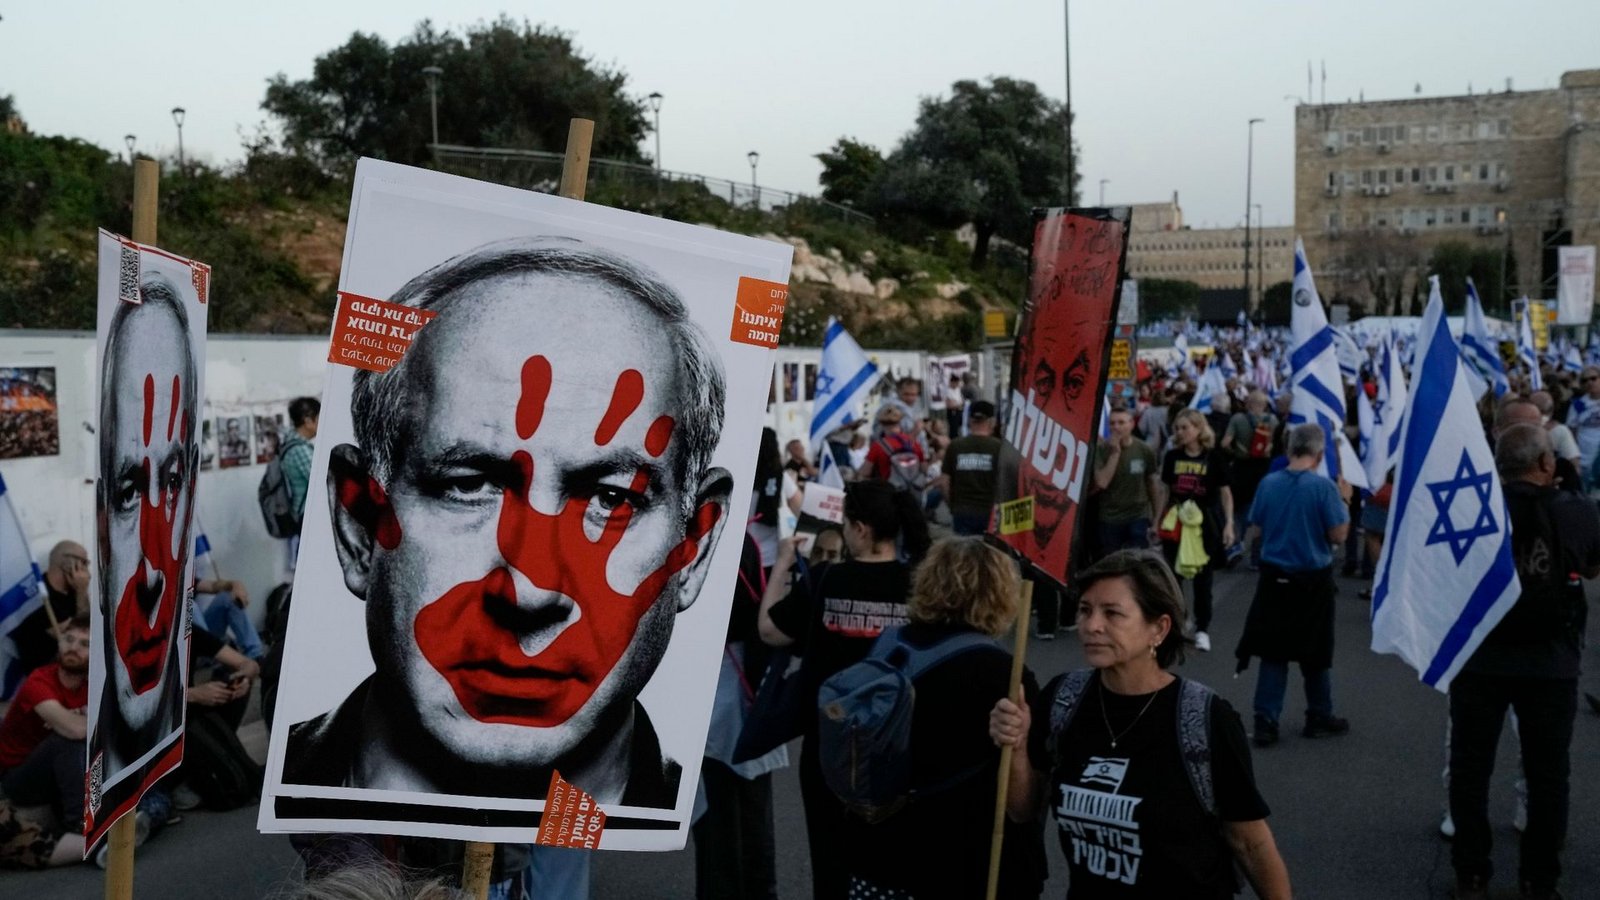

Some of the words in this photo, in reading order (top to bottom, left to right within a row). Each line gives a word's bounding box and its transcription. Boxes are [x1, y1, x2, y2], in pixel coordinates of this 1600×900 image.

[350, 301, 381, 317] סרקו
[383, 308, 402, 321] את
[740, 310, 778, 329] איתנו!
[347, 316, 387, 336] אנחנו
[343, 333, 357, 346] על
[360, 336, 384, 350] עתיד
[341, 348, 371, 365] בשביל
[1005, 387, 1089, 505] נכשלת
[570, 813, 588, 843] אותך
[1071, 837, 1141, 885] עכשיו
